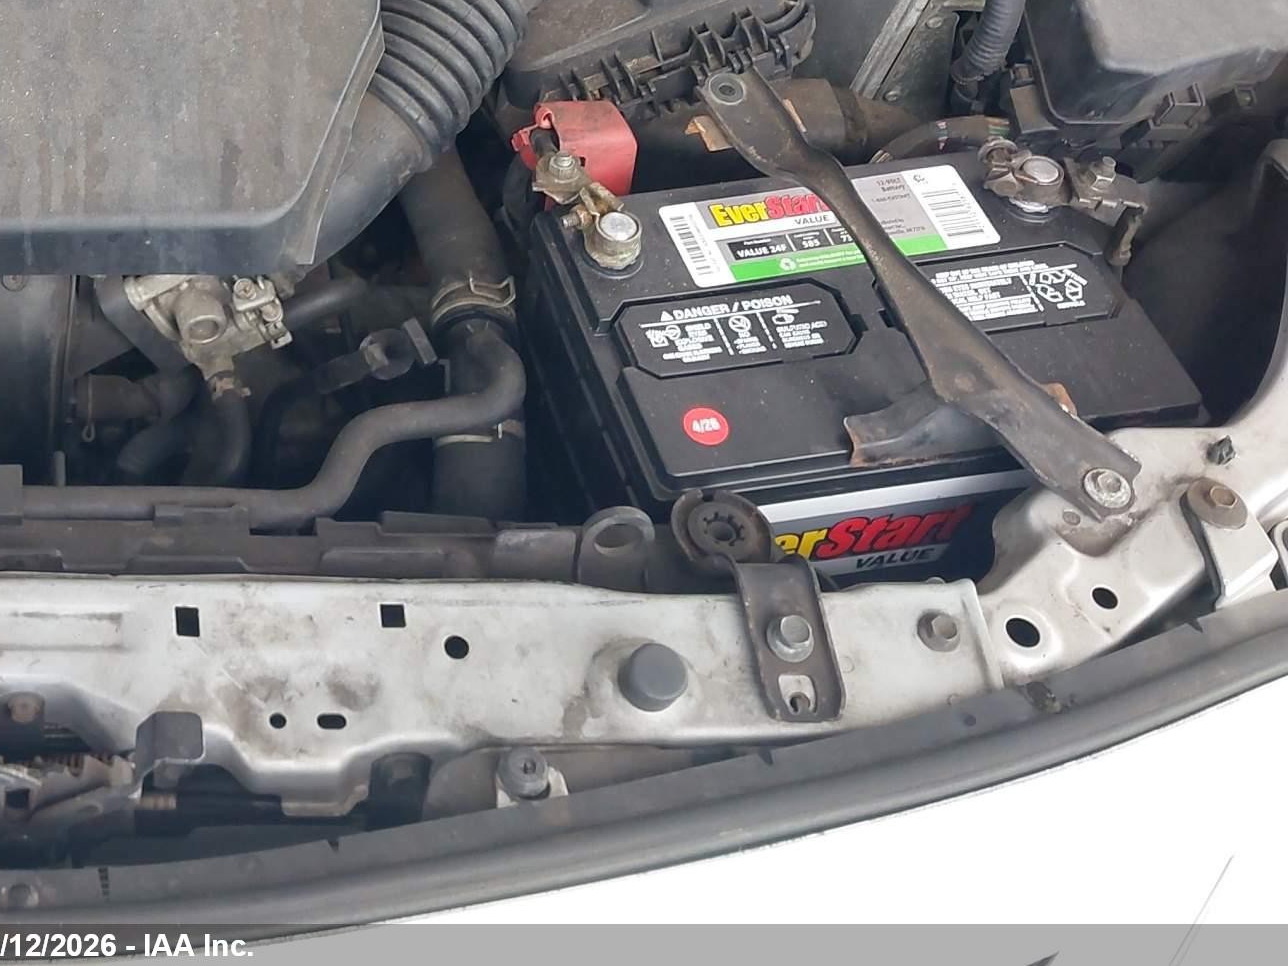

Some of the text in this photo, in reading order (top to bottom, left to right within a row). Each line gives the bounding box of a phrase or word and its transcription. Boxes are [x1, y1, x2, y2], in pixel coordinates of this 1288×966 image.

[709, 193, 830, 228] EverStar
[794, 214, 830, 226] VALUE
[737, 246, 769, 258] VALUE
[673, 303, 730, 320] DANGER
[741, 294, 794, 310] POISON
[774, 504, 971, 560] erStart
[856, 547, 935, 569] VALUE
